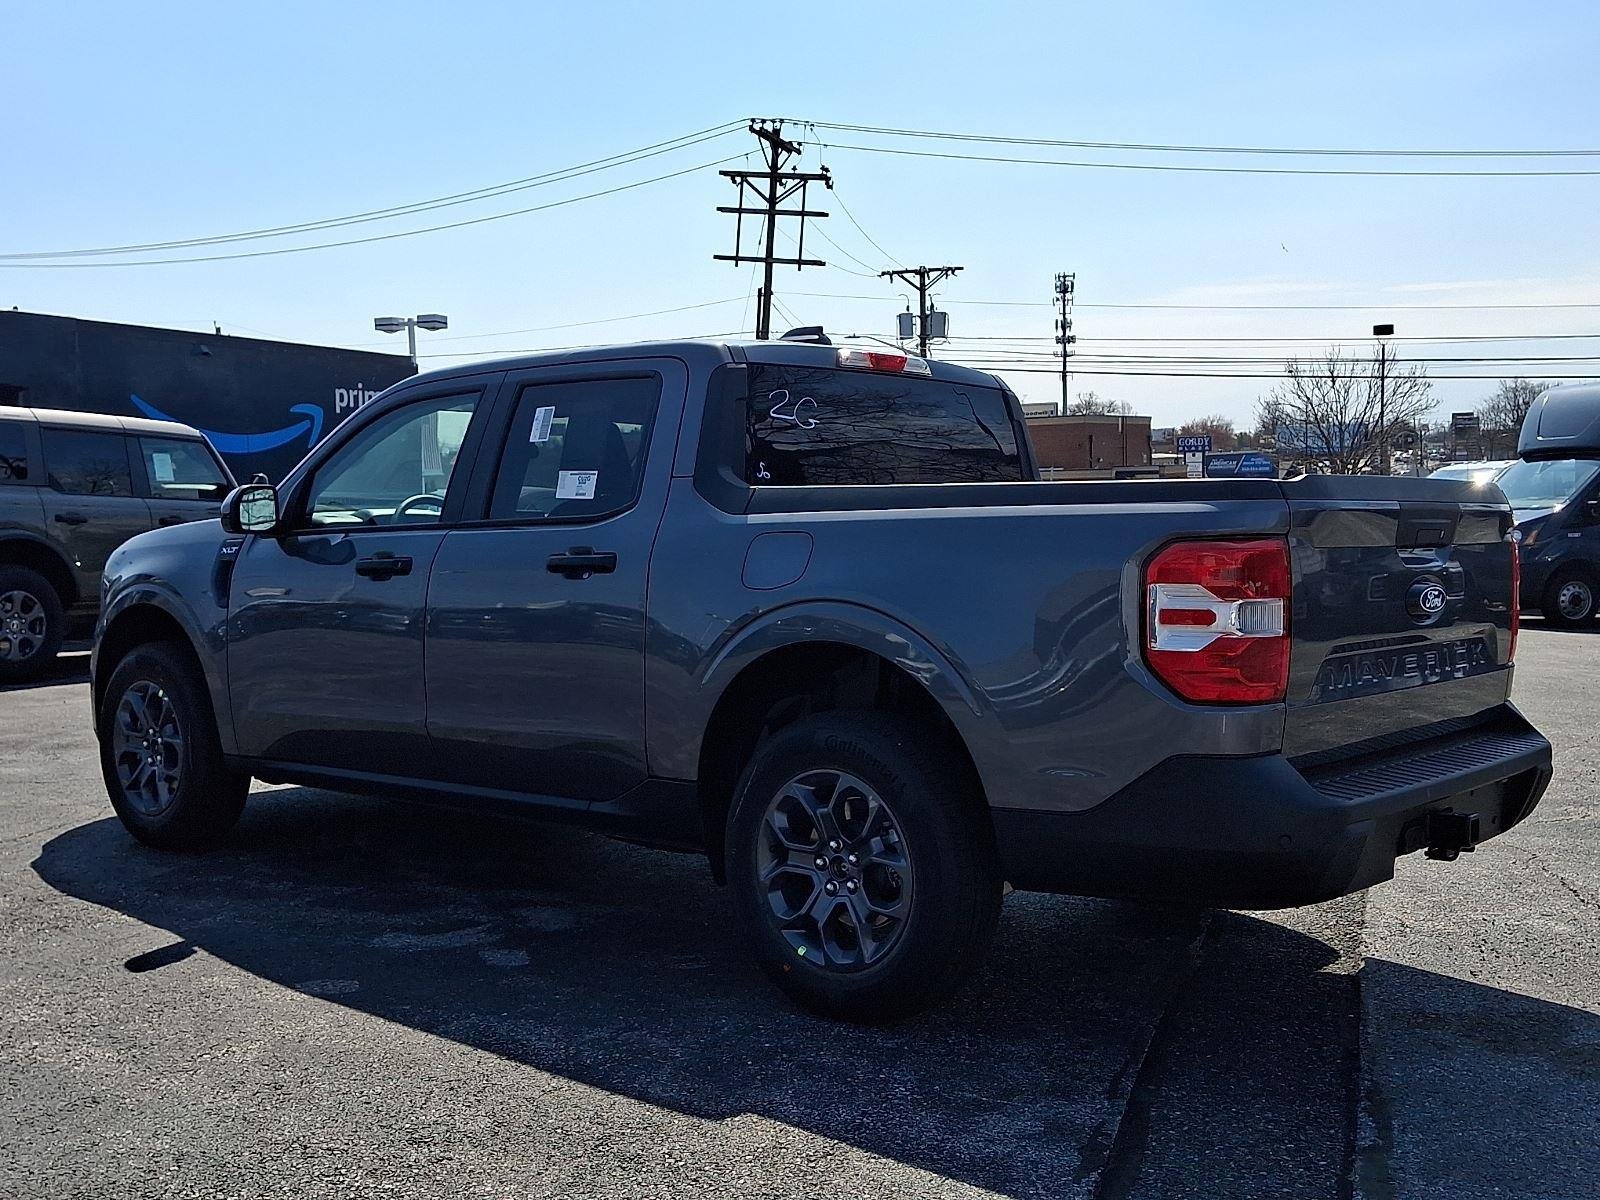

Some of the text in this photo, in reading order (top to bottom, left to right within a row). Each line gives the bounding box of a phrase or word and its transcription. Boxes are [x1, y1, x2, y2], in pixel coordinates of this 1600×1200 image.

[1178, 437, 1210, 446] GORDY
[221, 546, 239, 554] XLT
[1427, 590, 1443, 608] Ford
[1326, 641, 1486, 690] MAVERICK
